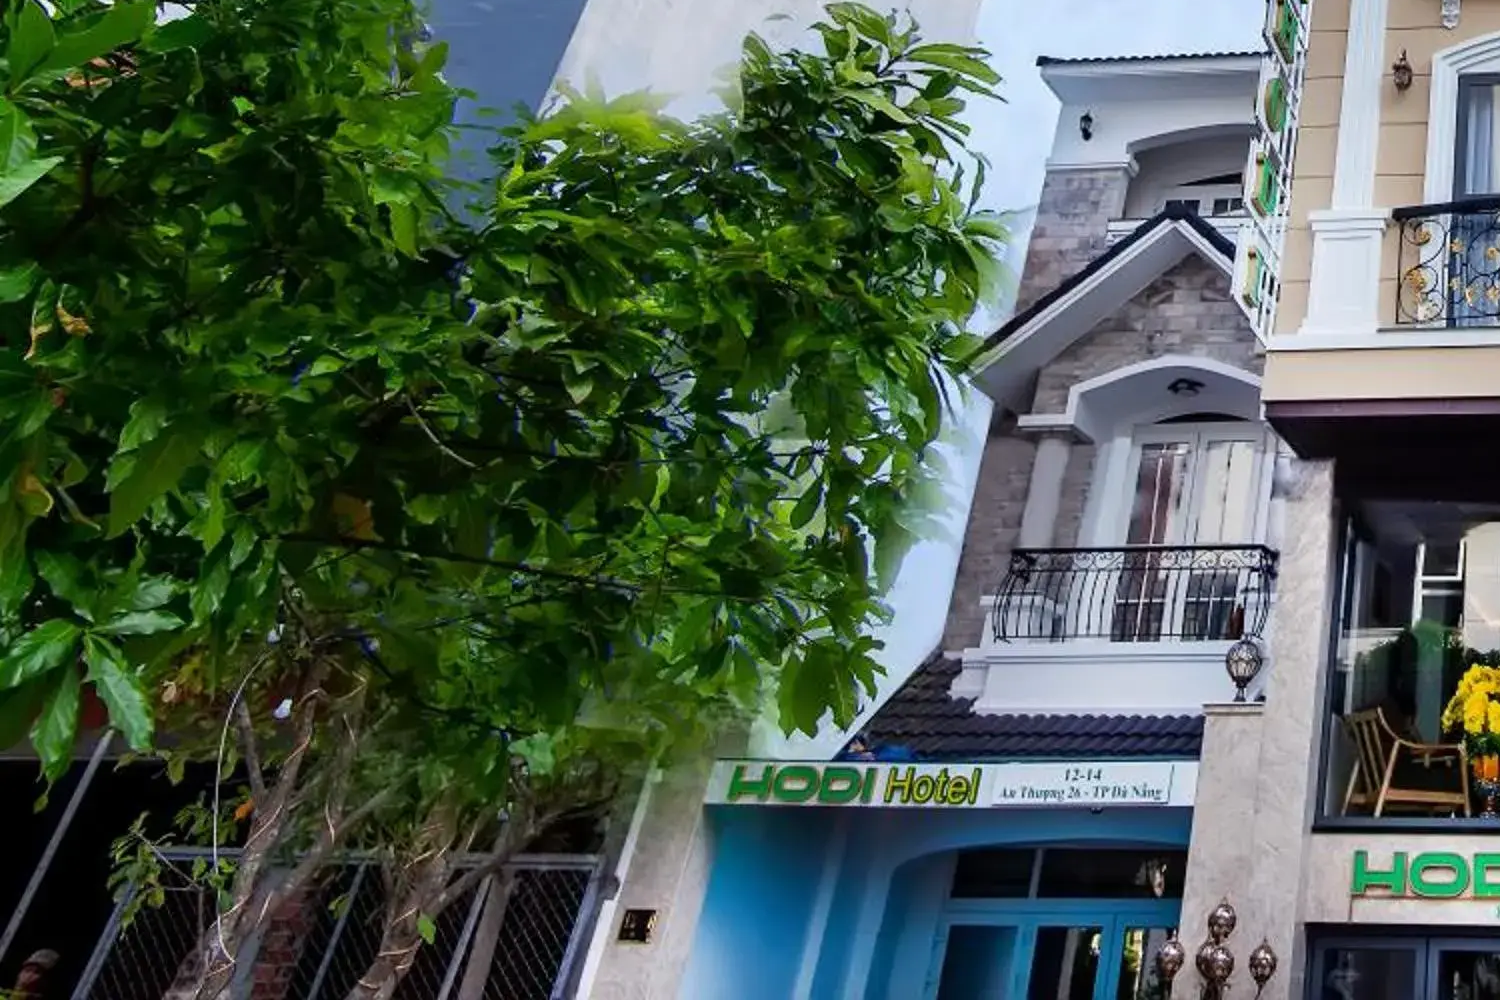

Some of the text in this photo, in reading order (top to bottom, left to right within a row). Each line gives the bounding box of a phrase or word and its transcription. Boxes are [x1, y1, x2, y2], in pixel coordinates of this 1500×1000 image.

[1064, 768, 1103, 781] 12-14
[727, 765, 982, 804] HODI Hotel
[1092, 785, 1111, 799] TP
